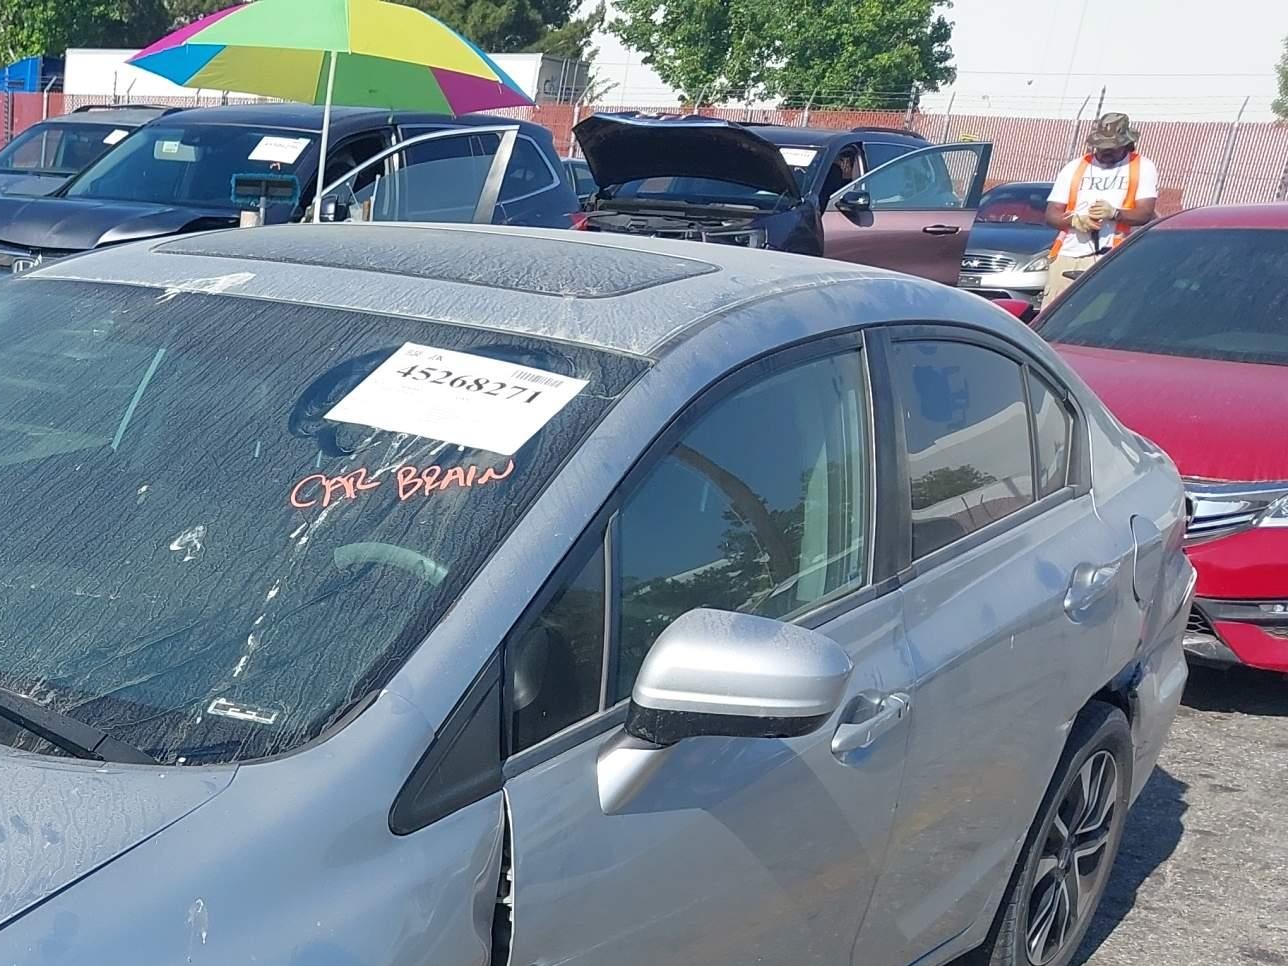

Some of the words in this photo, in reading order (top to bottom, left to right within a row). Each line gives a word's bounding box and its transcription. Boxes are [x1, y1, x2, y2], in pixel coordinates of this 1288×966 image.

[396, 364, 543, 404] 45268271
[290, 467, 381, 508] CAR
[397, 459, 515, 501] BRAIN
